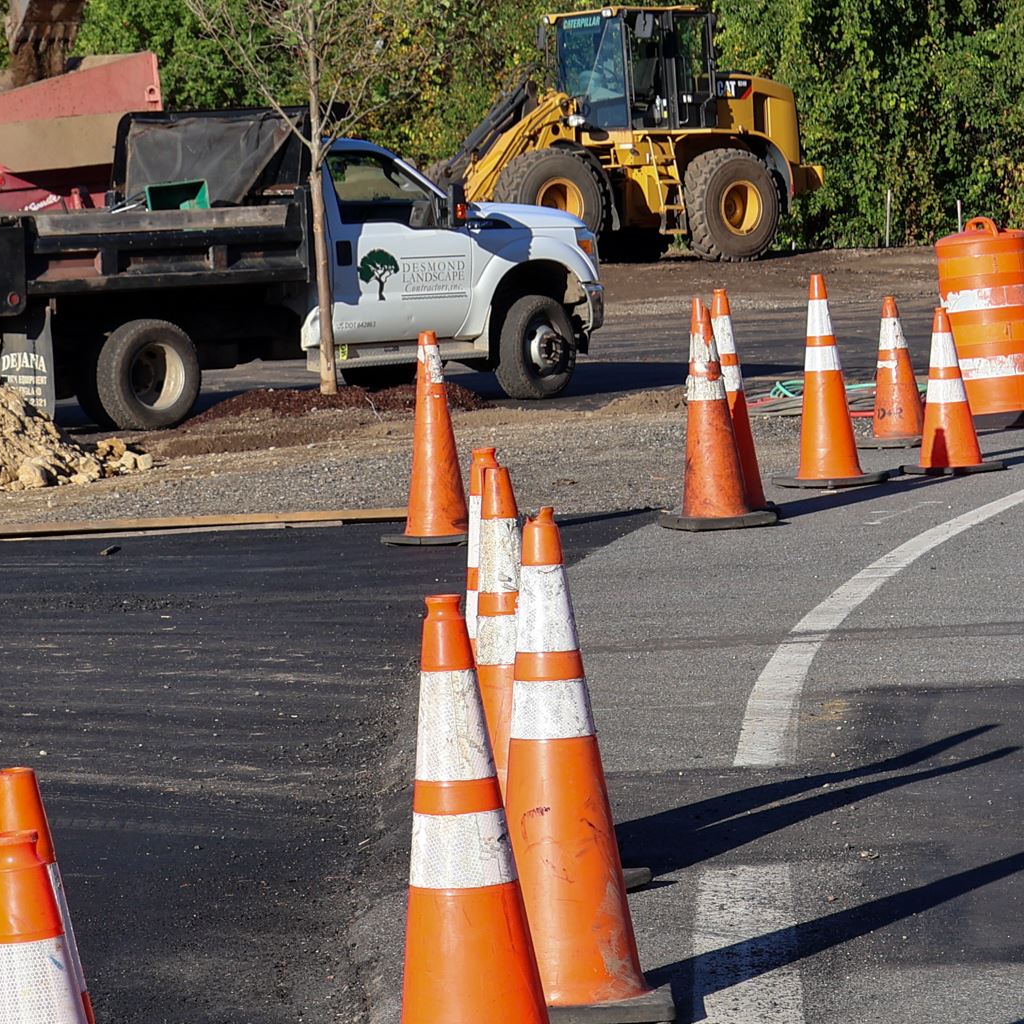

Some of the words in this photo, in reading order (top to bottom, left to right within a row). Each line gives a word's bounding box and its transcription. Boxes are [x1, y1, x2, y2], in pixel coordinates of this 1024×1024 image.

[563, 15, 601, 30] CATERPILLAR
[717, 80, 736, 97] CAT
[402, 261, 466, 273] DESMOND
[402, 271, 465, 283] LANDSCAPE
[1, 351, 47, 373] DEJANA
